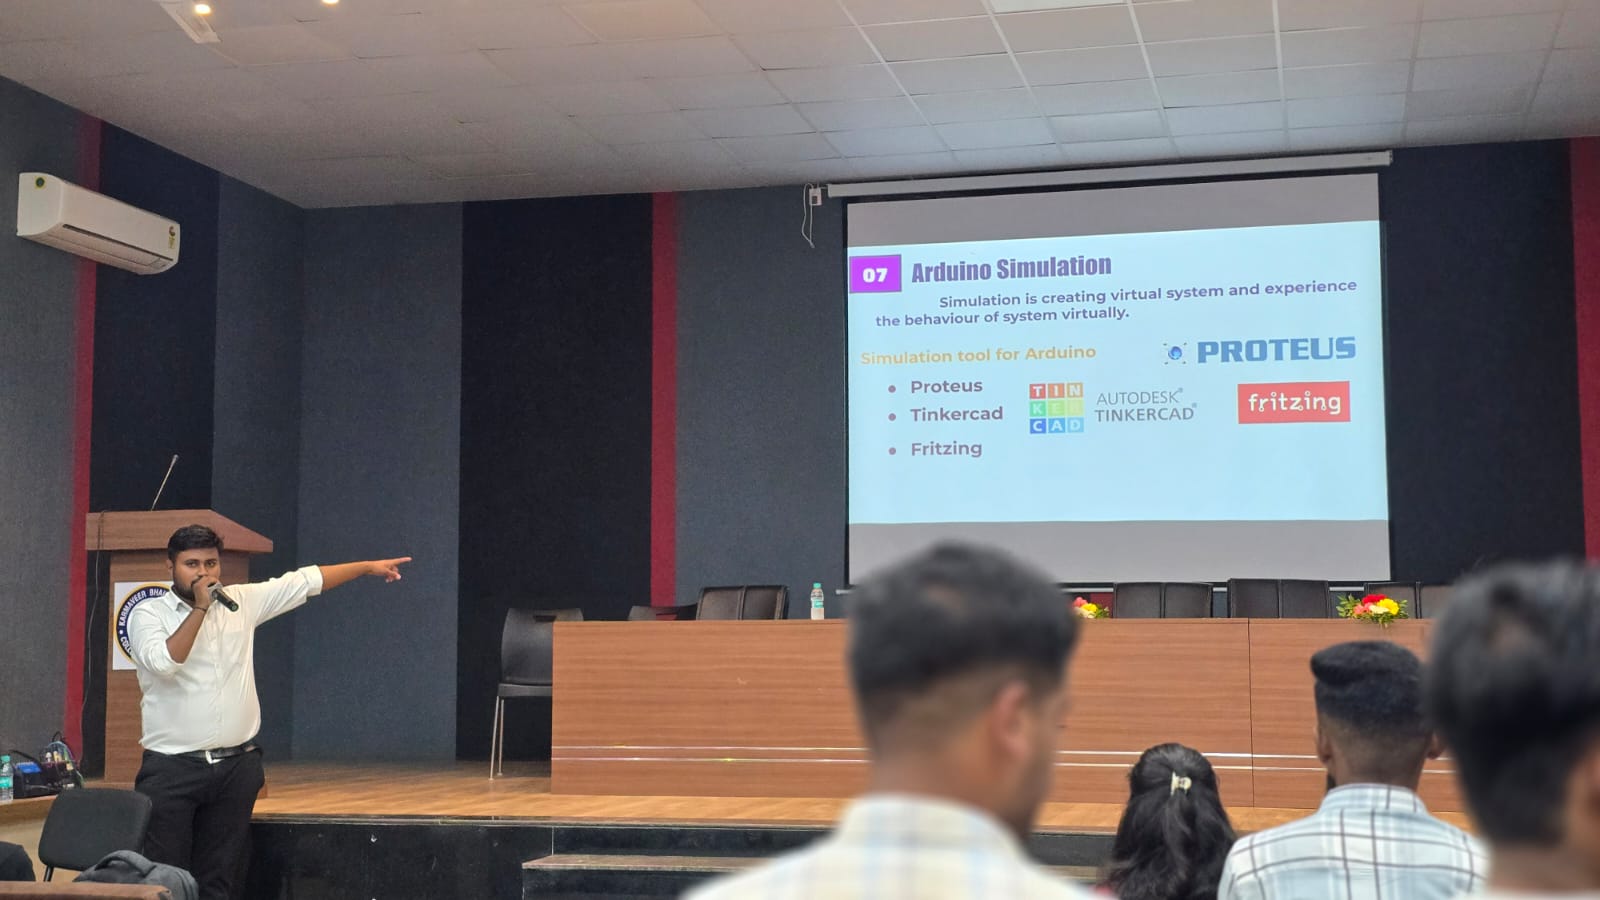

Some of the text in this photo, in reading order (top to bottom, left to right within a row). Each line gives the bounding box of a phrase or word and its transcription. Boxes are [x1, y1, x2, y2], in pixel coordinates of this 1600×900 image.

[862, 255, 1112, 283] 07 Arduino Simulation
[939, 279, 1357, 308] Simulation is creating virtual system and experience
[875, 306, 1130, 327] the behaviour of system virtually.
[860, 346, 1096, 365] Simulation tool for Arduino
[1197, 336, 1356, 363] PROTEUS
[911, 380, 983, 394] Proteus
[1096, 390, 1179, 406] AUTODESK
[1248, 390, 1341, 415] fritzing
[910, 406, 1004, 422] Tinkercad
[1094, 407, 1195, 423] TINKERCAD
[911, 441, 983, 458] Fritzing
[118, 590, 147, 626] KARMAVEER
